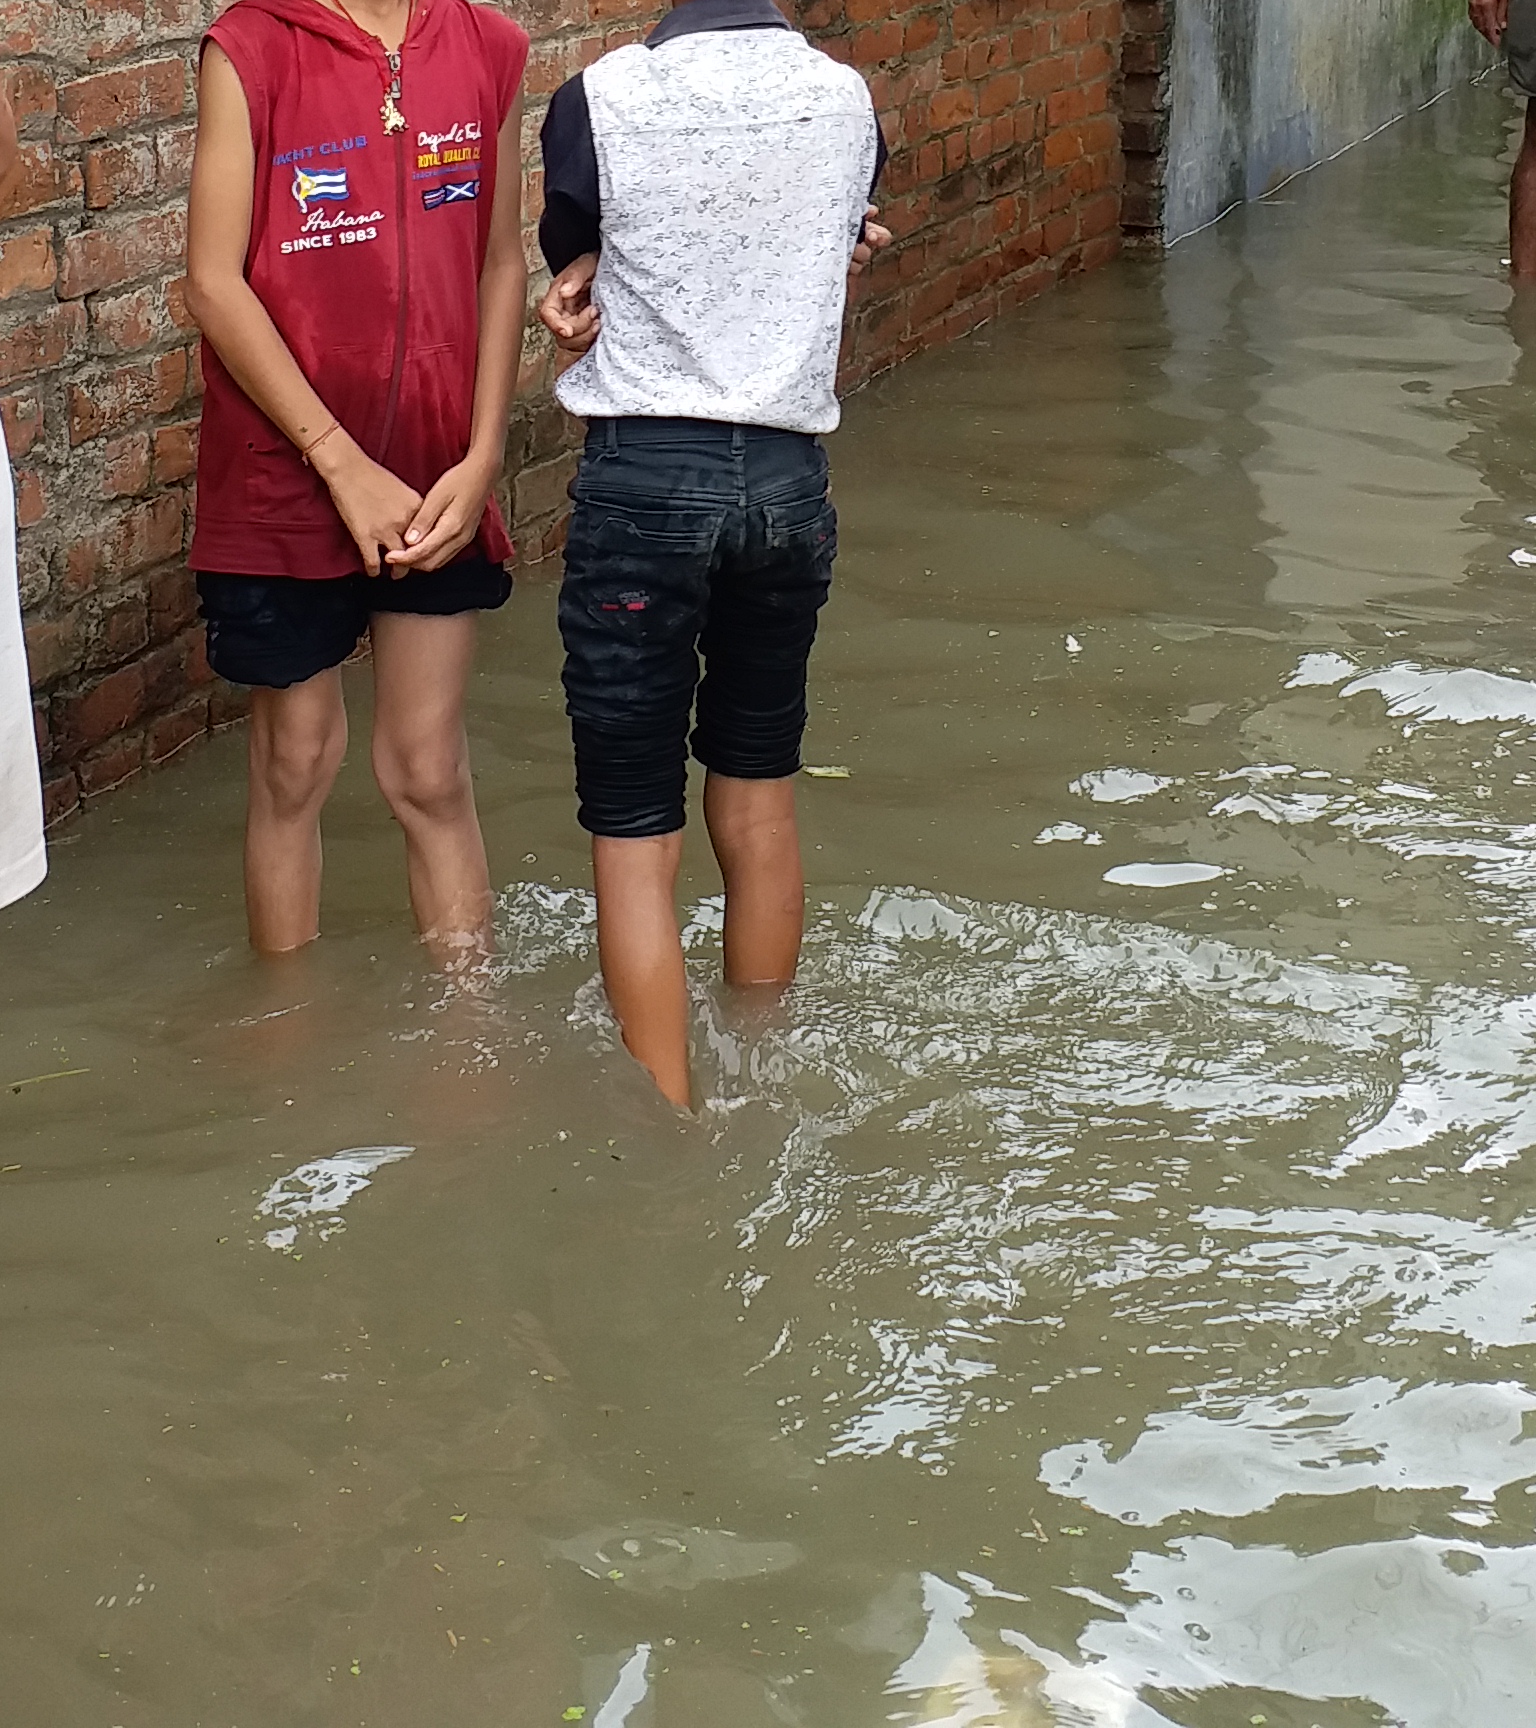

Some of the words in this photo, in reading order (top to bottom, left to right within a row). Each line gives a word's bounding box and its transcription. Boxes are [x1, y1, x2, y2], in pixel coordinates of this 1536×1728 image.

[319, 135, 368, 155] CLUB
[418, 153, 441, 168] ROYAL
[301, 208, 384, 232] Habana
[281, 234, 333, 253] SINCE
[339, 227, 377, 244] 1983
